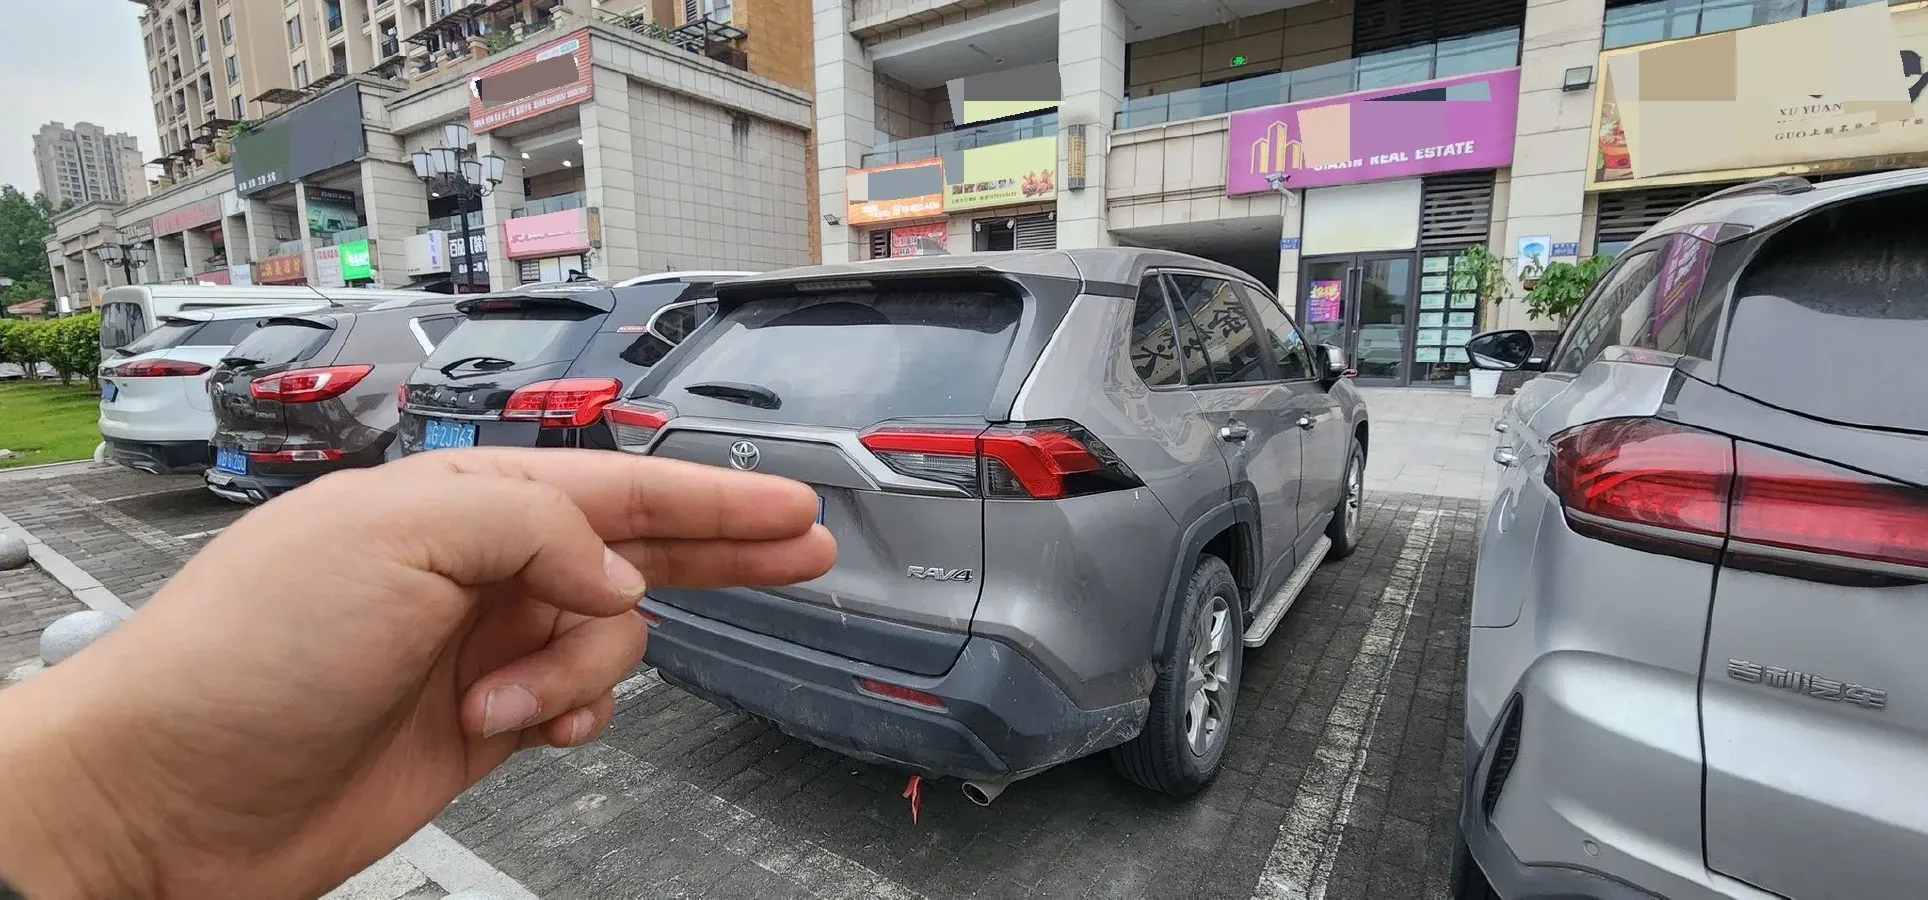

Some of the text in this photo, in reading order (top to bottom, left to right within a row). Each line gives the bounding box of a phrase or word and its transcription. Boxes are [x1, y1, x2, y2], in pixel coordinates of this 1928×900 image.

[1802, 102, 1843, 115] YUAN
[1370, 152, 1408, 166] REAL
[1415, 140, 1475, 160] ESTATE
[906, 565, 974, 583] RAV4
[1727, 658, 1887, 710] 吉利汽车
